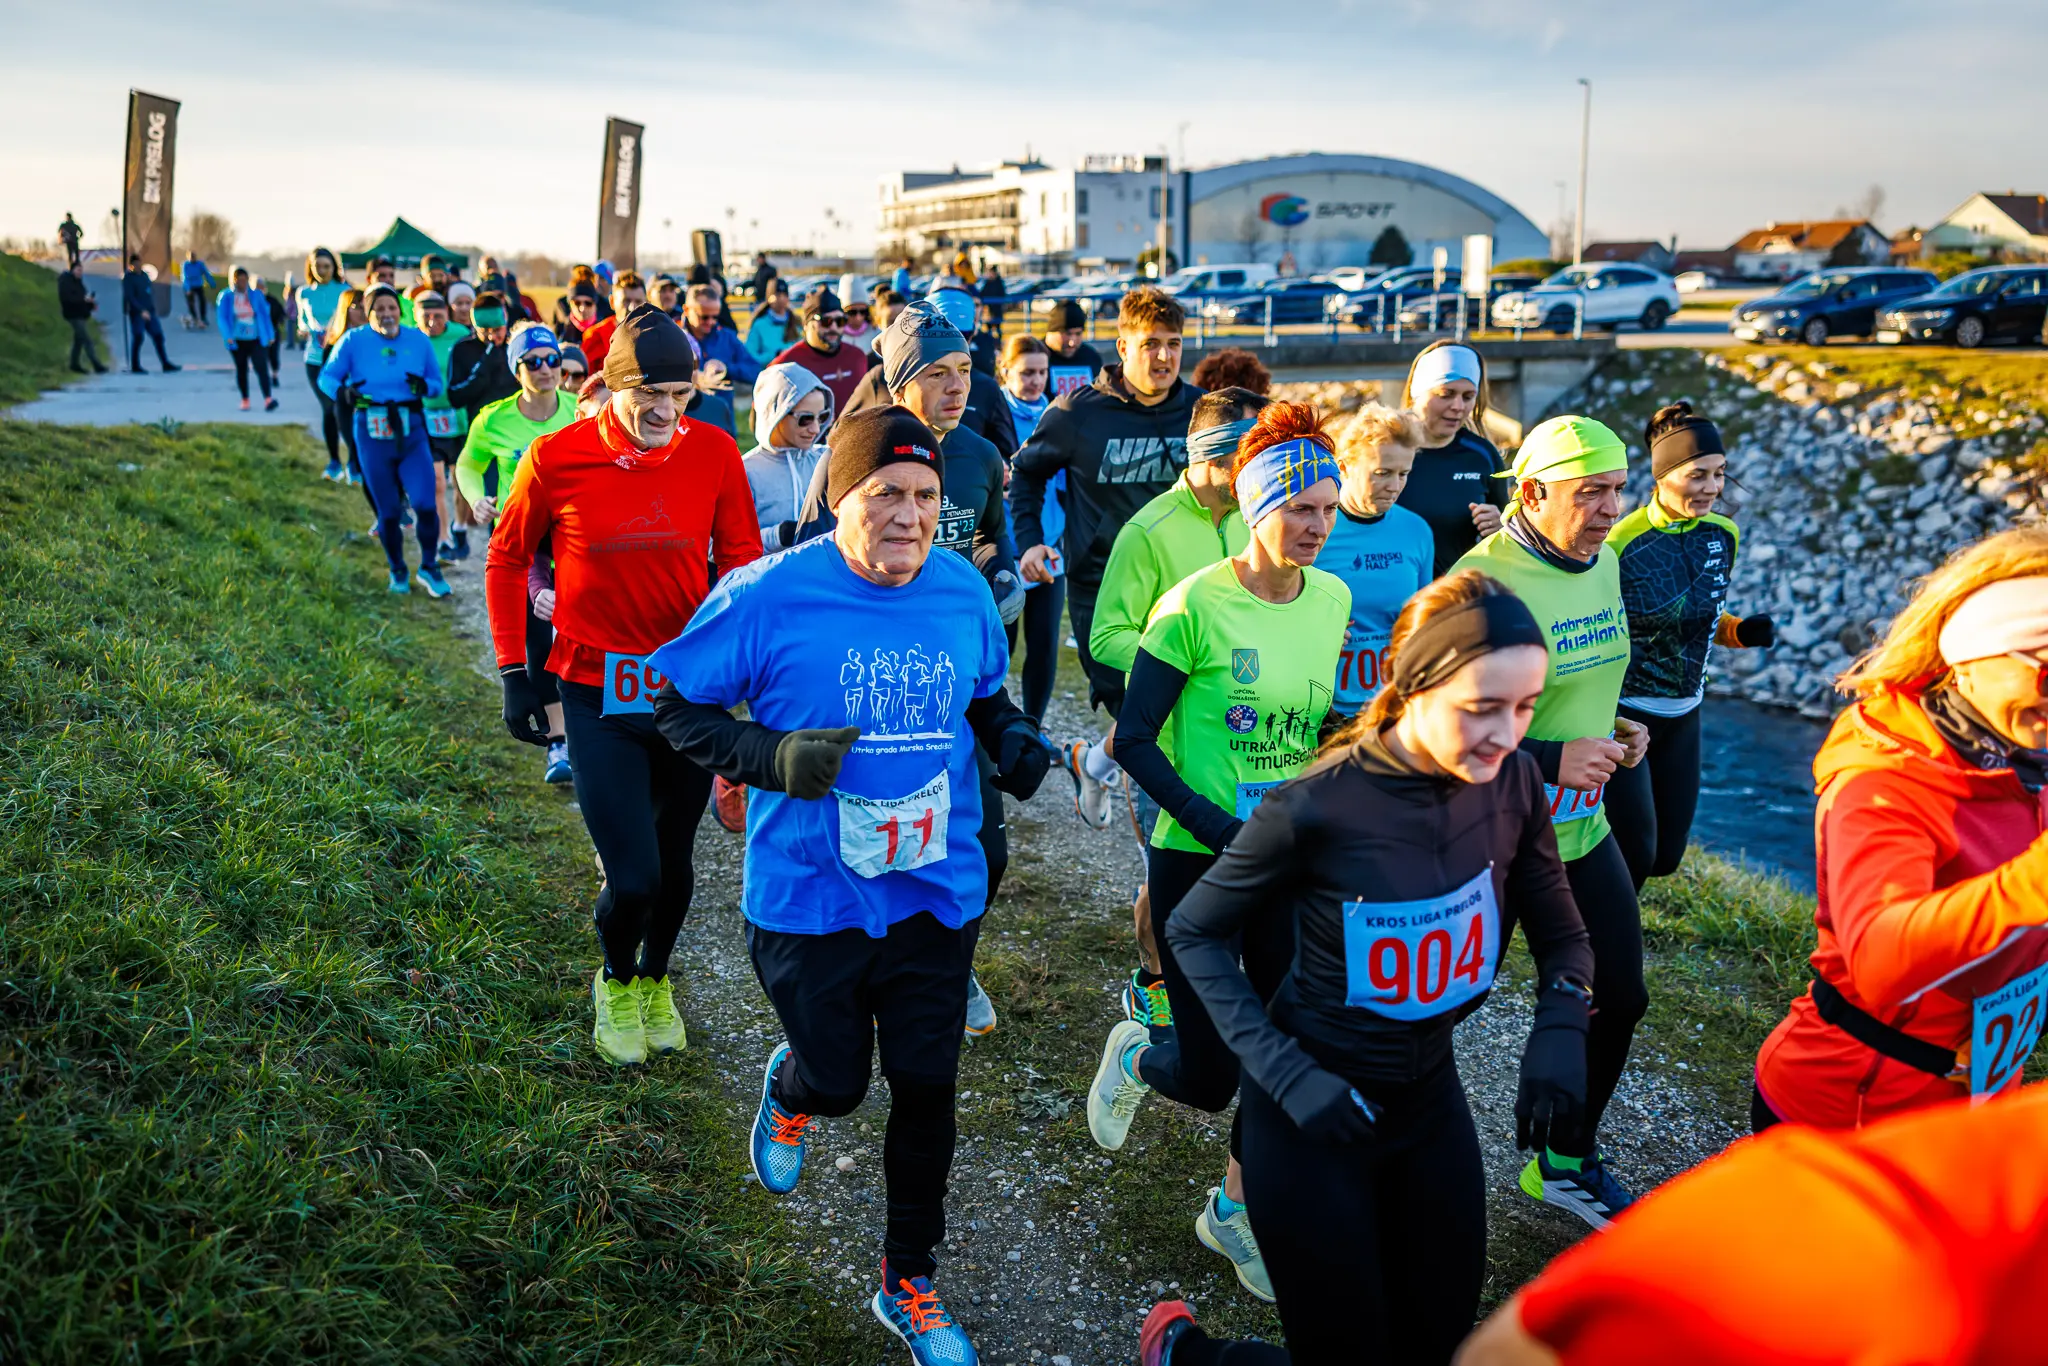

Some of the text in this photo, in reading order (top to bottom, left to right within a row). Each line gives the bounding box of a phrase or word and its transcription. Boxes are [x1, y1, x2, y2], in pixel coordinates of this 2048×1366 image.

[145, 111, 167, 179] PRELOG
[1315, 201, 1397, 219] SPORT
[1364, 552, 1402, 562] ZRINSKI
[1365, 560, 1390, 571] HALF
[1551, 607, 1614, 636] dobravski
[1556, 625, 1619, 656] duatlon
[851, 746, 874, 754] Utrka
[876, 746, 898, 755] grada
[899, 744, 924, 753] Mursko
[1229, 739, 1277, 753] UTRKA
[1246, 787, 1269, 798] KRO
[876, 807, 934, 865] 11
[1366, 890, 1483, 928] KROS LIGA PRELOG
[1368, 912, 1485, 1005] 904
[1981, 977, 2038, 1014] KROS LIGA
[1984, 995, 2041, 1093] 22
